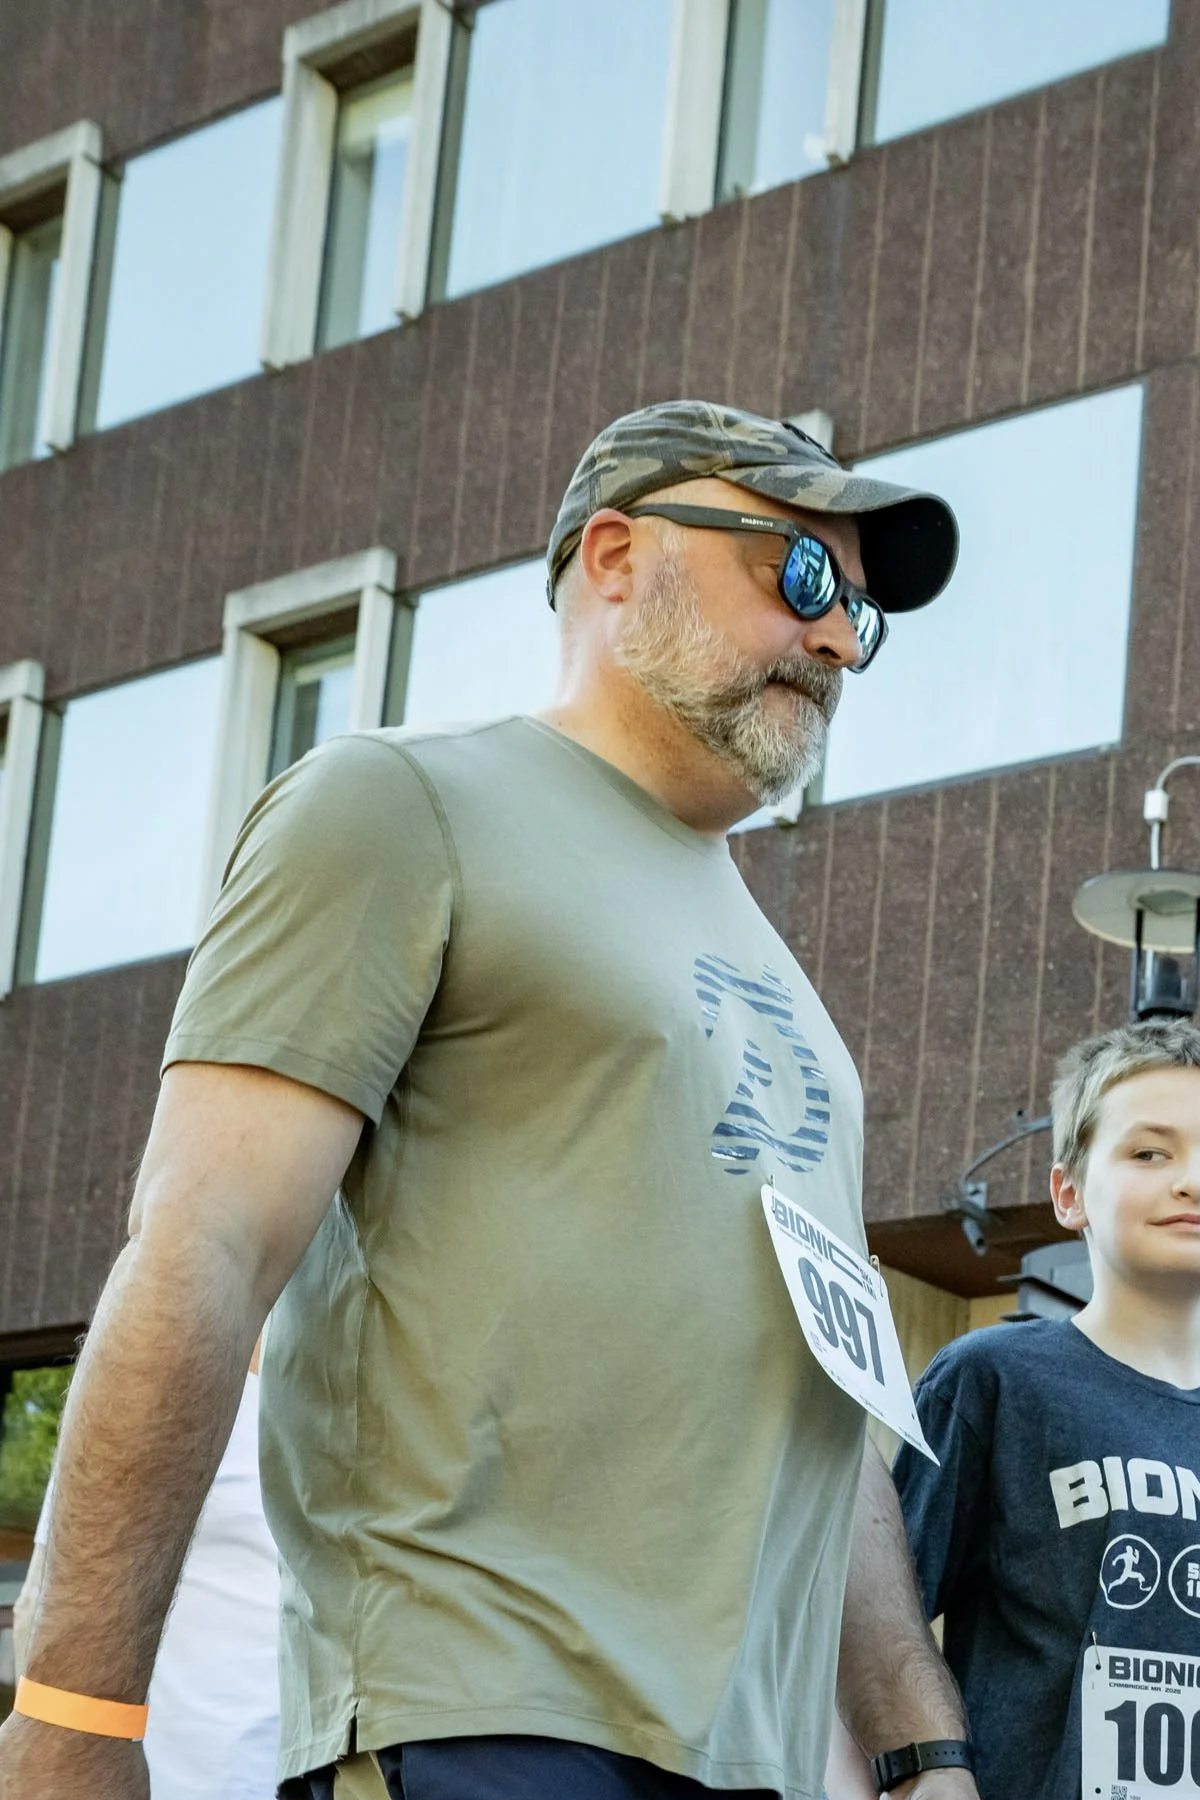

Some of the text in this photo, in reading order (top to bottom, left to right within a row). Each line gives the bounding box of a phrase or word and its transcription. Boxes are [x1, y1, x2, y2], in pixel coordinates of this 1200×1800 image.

[774, 1197, 863, 1288] BIONIC
[798, 1256, 885, 1387] 997
[1108, 1681, 1149, 1691] CAMBRIDGE
